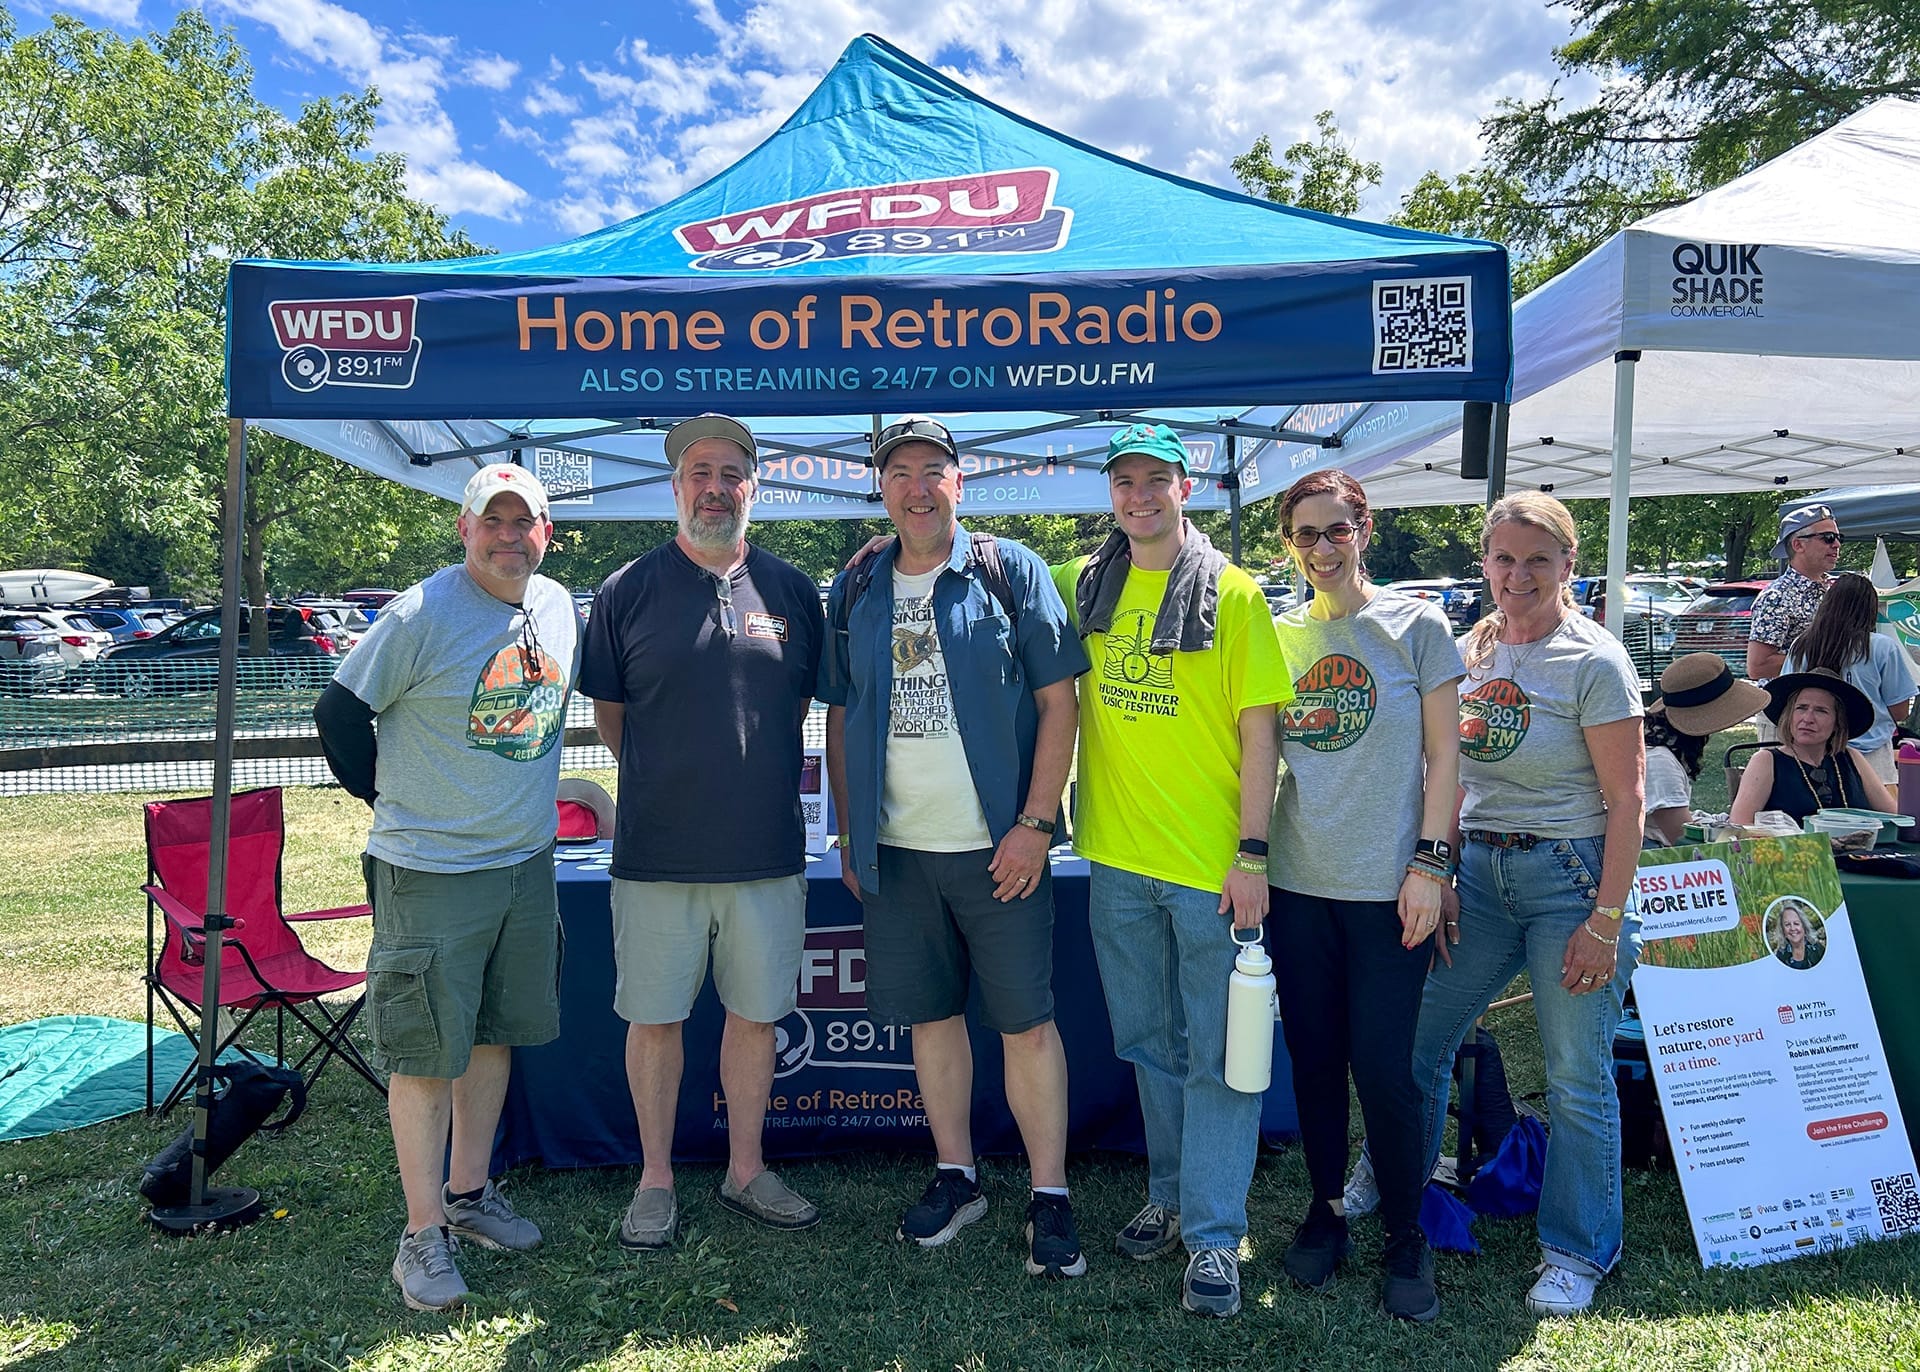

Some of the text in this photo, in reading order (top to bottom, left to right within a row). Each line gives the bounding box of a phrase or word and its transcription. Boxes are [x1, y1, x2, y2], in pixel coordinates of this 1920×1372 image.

[706, 185, 1021, 245] WFDU
[1672, 243, 1763, 275] QUIK
[1672, 277, 1764, 304] SHADE
[517, 288, 1223, 351] Home of RetroRadio
[1670, 305, 1764, 318] COMMERCIAL
[281, 310, 403, 341] WFDU
[580, 362, 1155, 392] ALSO STREAMING 24/7 ON WFDU.FM
[892, 609, 935, 625] SINGL
[1298, 655, 1367, 691] WFDU
[1099, 683, 1179, 705] HUDSON RIVER
[1336, 689, 1369, 713] 89.1
[1101, 695, 1178, 717] USIC FESTIVAL
[893, 719, 948, 733] WORLD.
[1337, 710, 1367, 733] FM
[1487, 704, 1523, 730] 89.1
[1316, 730, 1359, 750] RETRORADIO
[1486, 727, 1518, 748] FM
[1638, 869, 1723, 894] ESS LAWN
[1691, 889, 1728, 909] LIFE
[1643, 915, 1728, 931] www.LessLawnMoreLife.com
[800, 948, 867, 993] FD
[1796, 1001, 1826, 1011] MAY 7TH
[1804, 1011, 1813, 1020] PT
[1823, 1008, 1836, 1017] EST
[1687, 1016, 1734, 1032] restore
[1658, 1028, 1764, 1055] nature, one yard
[1794, 1032, 1848, 1047] Live Kickoff with
[1789, 1042, 1859, 1059] Robin Wall Kimmerer
[1663, 1056, 1721, 1074] at a time.
[1668, 1083, 1683, 1091] Learn
[1713, 1077, 1725, 1085] your
[1725, 1075, 1737, 1084] yard
[1752, 1069, 1772, 1078] thriving
[1732, 1080, 1750, 1089] weekly
[796, 1090, 822, 1110] of
[829, 1089, 926, 1110] RetroRa
[1673, 1099, 1685, 1107] Real
[764, 1114, 837, 1128] TREAMING
[841, 1115, 871, 1127] 24/7
[874, 1115, 897, 1127] ON
[1690, 1117, 1746, 1131] Fun weekly challenges
[1812, 1127, 1826, 1135] Join
[1837, 1123, 1852, 1131] Free
[1852, 1118, 1883, 1128] Challenge
[1693, 1131, 1733, 1143] Expert speakers
[1708, 1145, 1720, 1153] land
[1720, 1140, 1750, 1151] assessment
[1700, 1156, 1745, 1169] Prizes and badges
